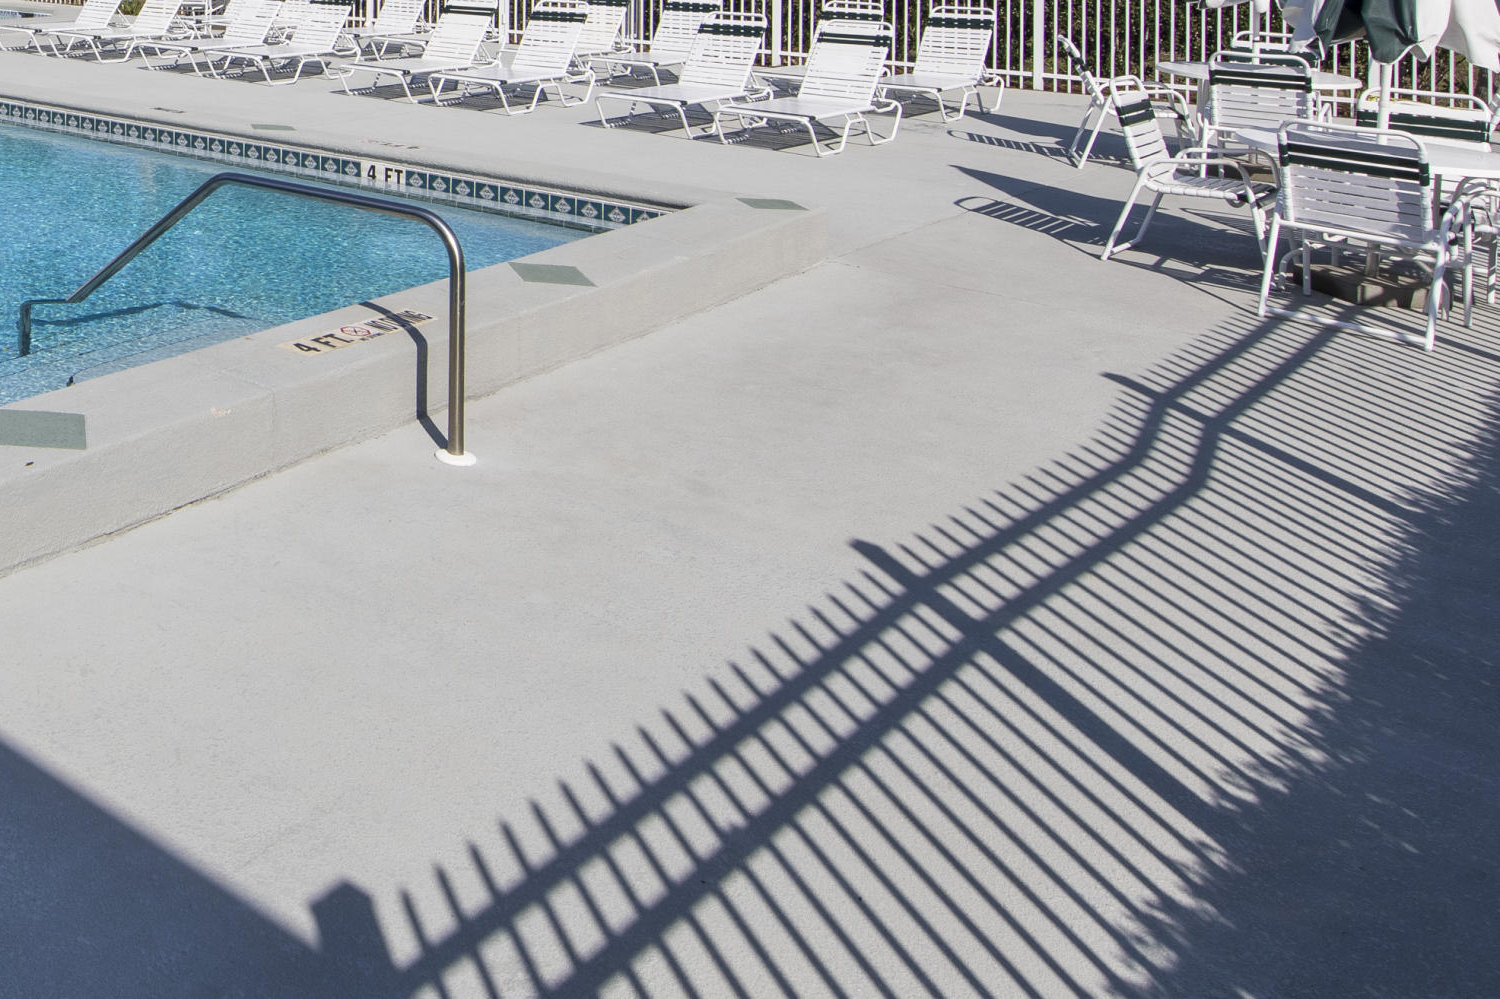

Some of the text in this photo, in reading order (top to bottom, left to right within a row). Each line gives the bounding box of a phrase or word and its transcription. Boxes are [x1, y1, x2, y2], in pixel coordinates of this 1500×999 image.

[367, 164, 403, 184] 4 FT
[293, 342, 322, 352] 4
